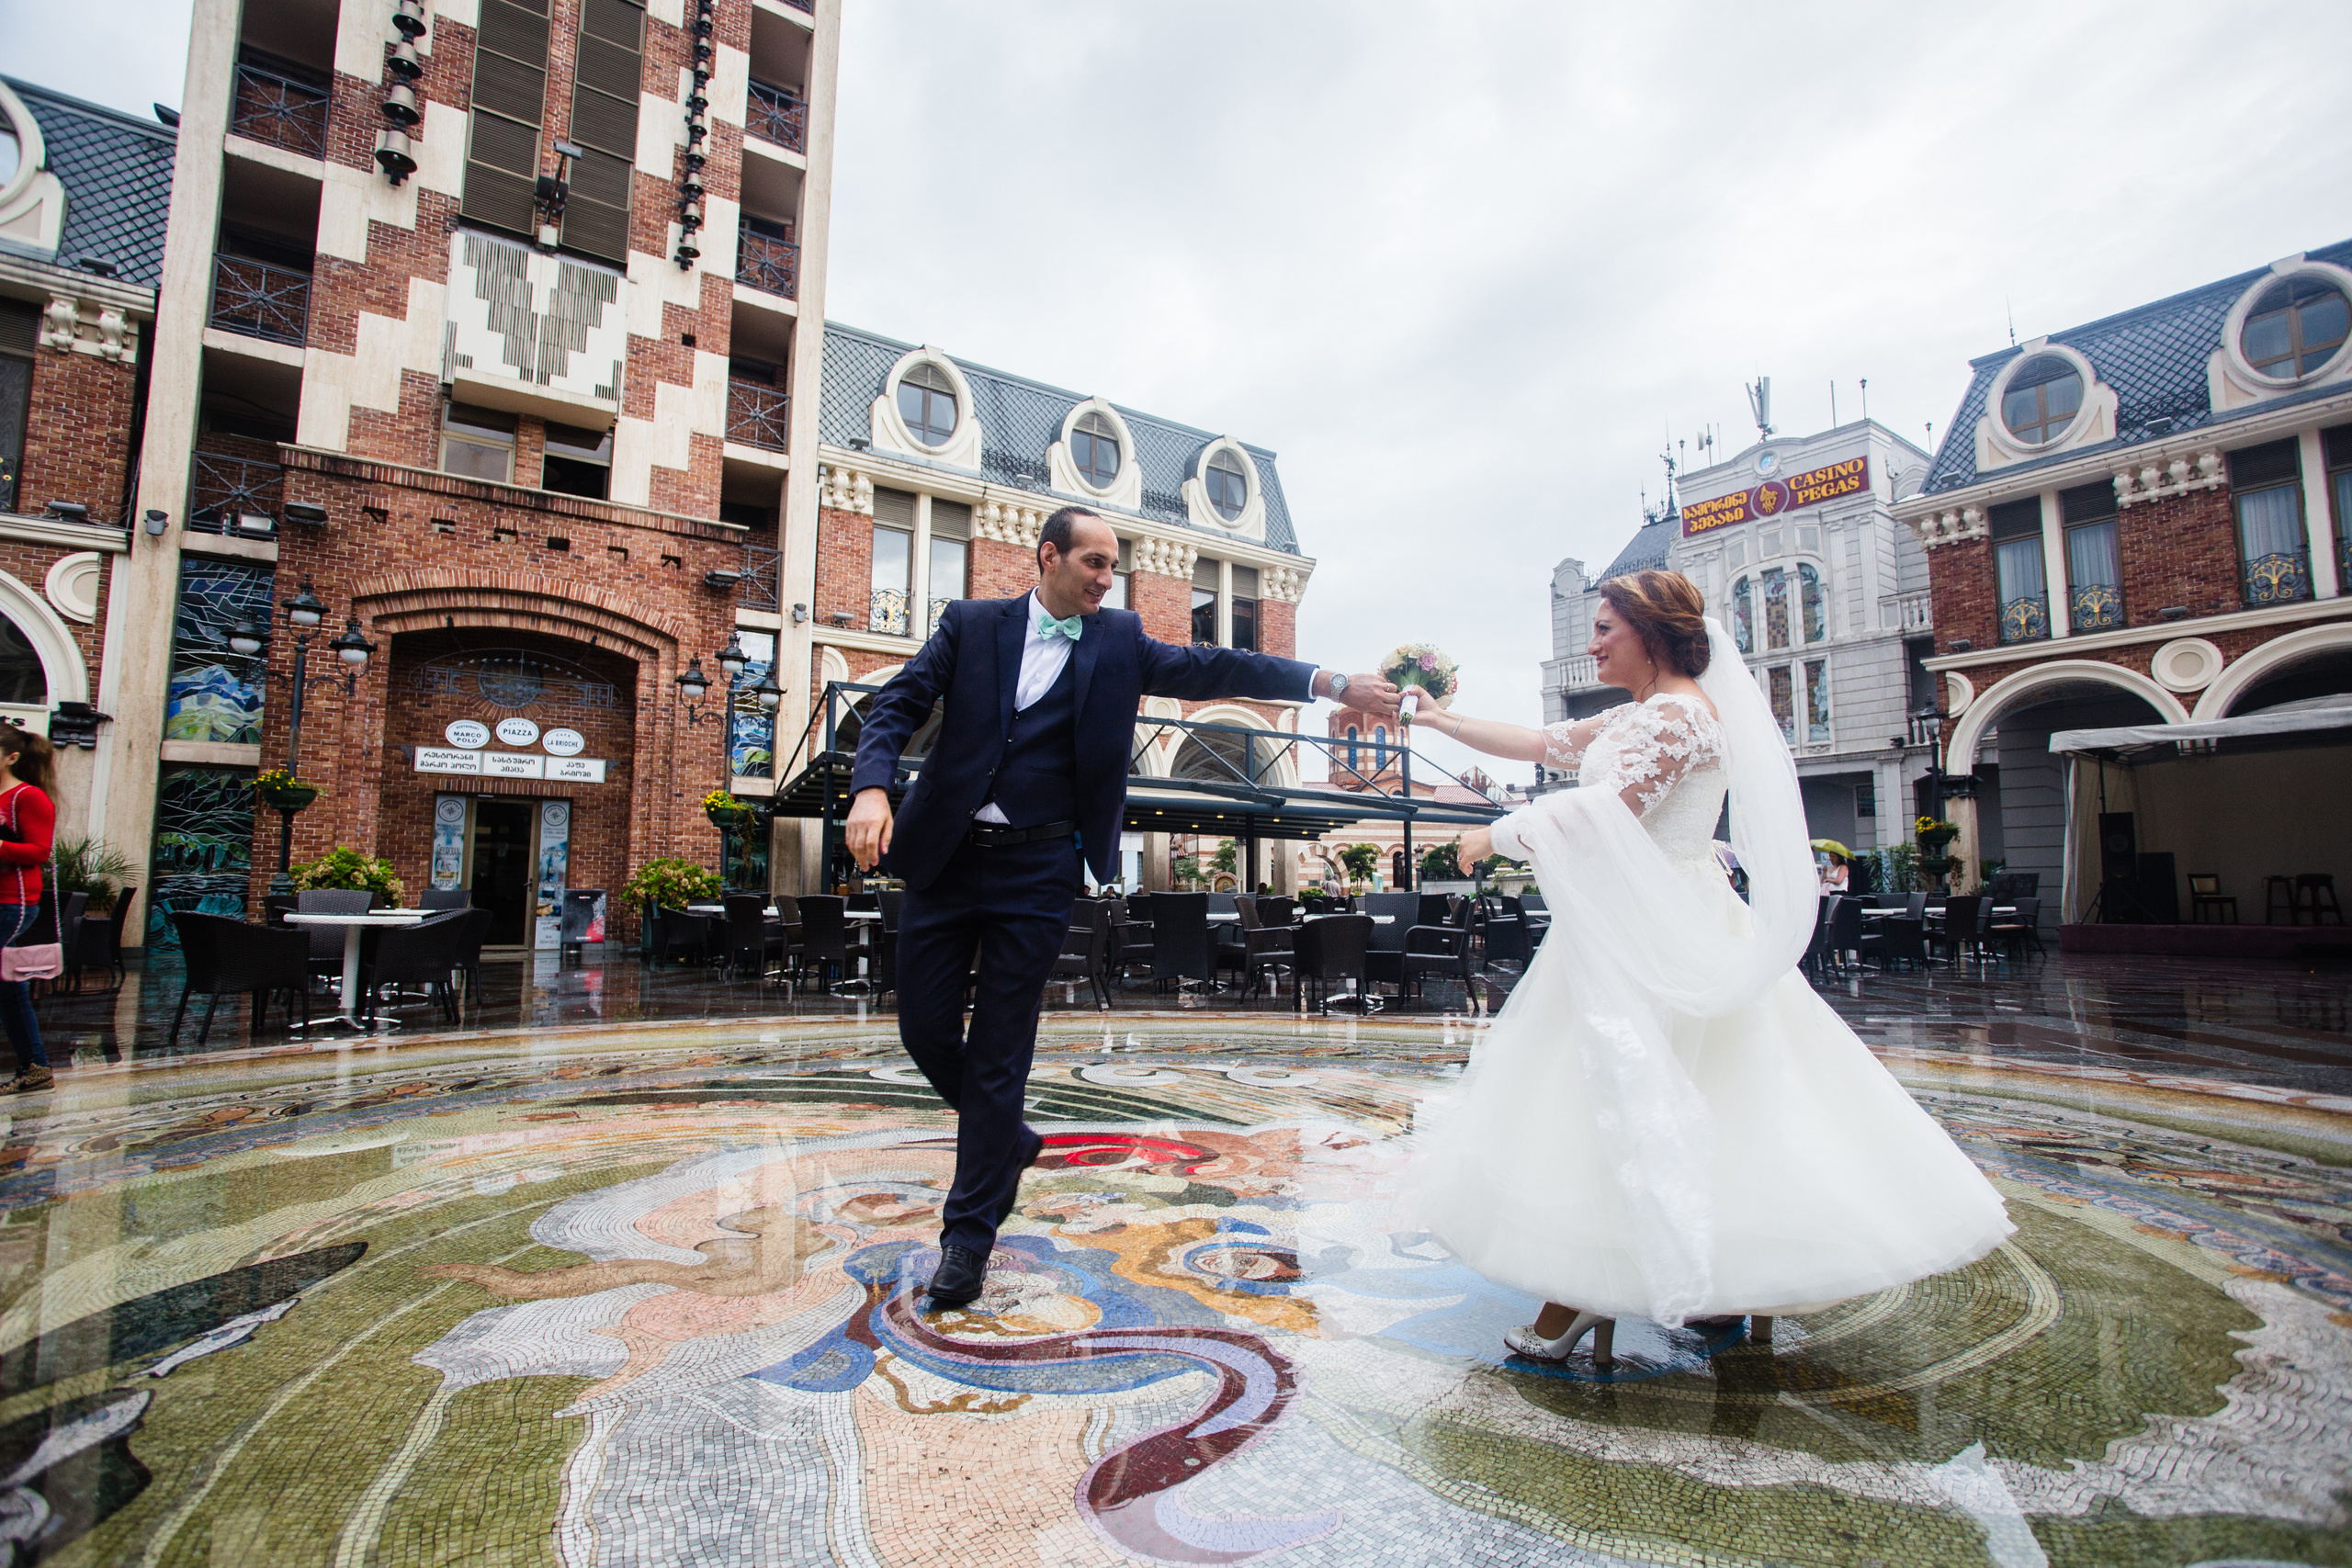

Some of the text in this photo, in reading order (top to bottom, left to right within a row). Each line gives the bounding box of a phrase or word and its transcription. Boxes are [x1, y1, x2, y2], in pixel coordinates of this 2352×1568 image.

[1790, 458, 1864, 491] CASINO
[1797, 475, 1860, 505] PEGAS
[503, 728, 532, 737] PIAZZA
[555, 739, 579, 748] BRIOCHE
